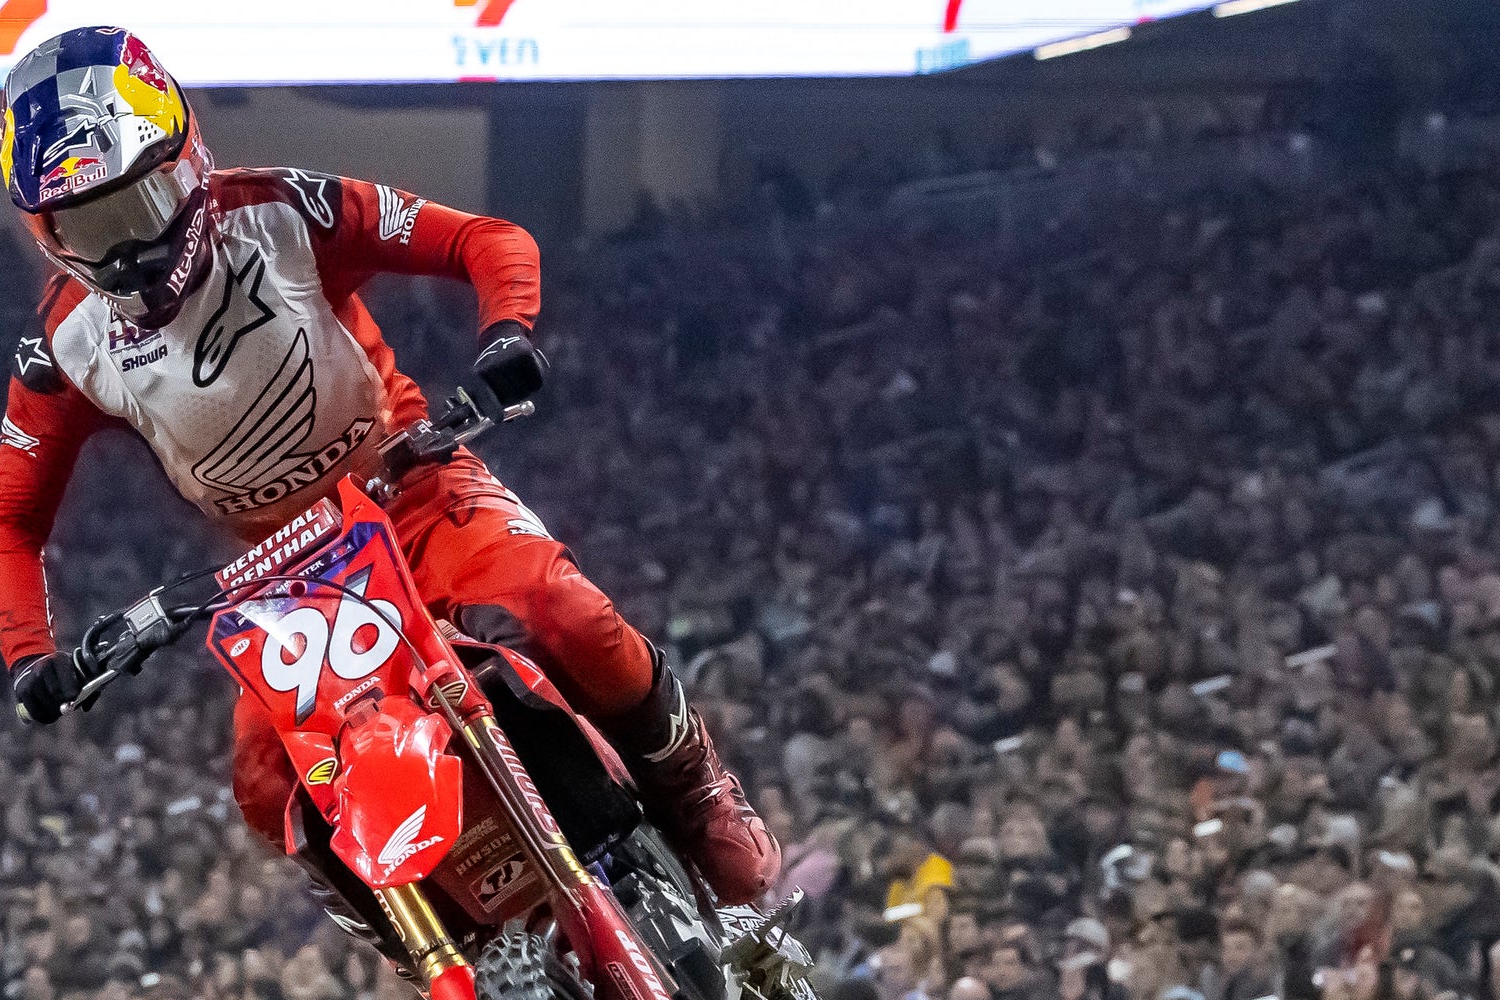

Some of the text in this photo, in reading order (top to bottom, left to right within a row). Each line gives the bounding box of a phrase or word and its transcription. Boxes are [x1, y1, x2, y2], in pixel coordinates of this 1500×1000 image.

[40, 166, 107, 202] Red Bull
[121, 344, 168, 373] SHOWA
[214, 416, 376, 516] HONDA
[222, 507, 320, 581] RENTHAL
[261, 566, 402, 728] 96
[333, 675, 381, 710] HONDA
[383, 834, 445, 878] HONDA
